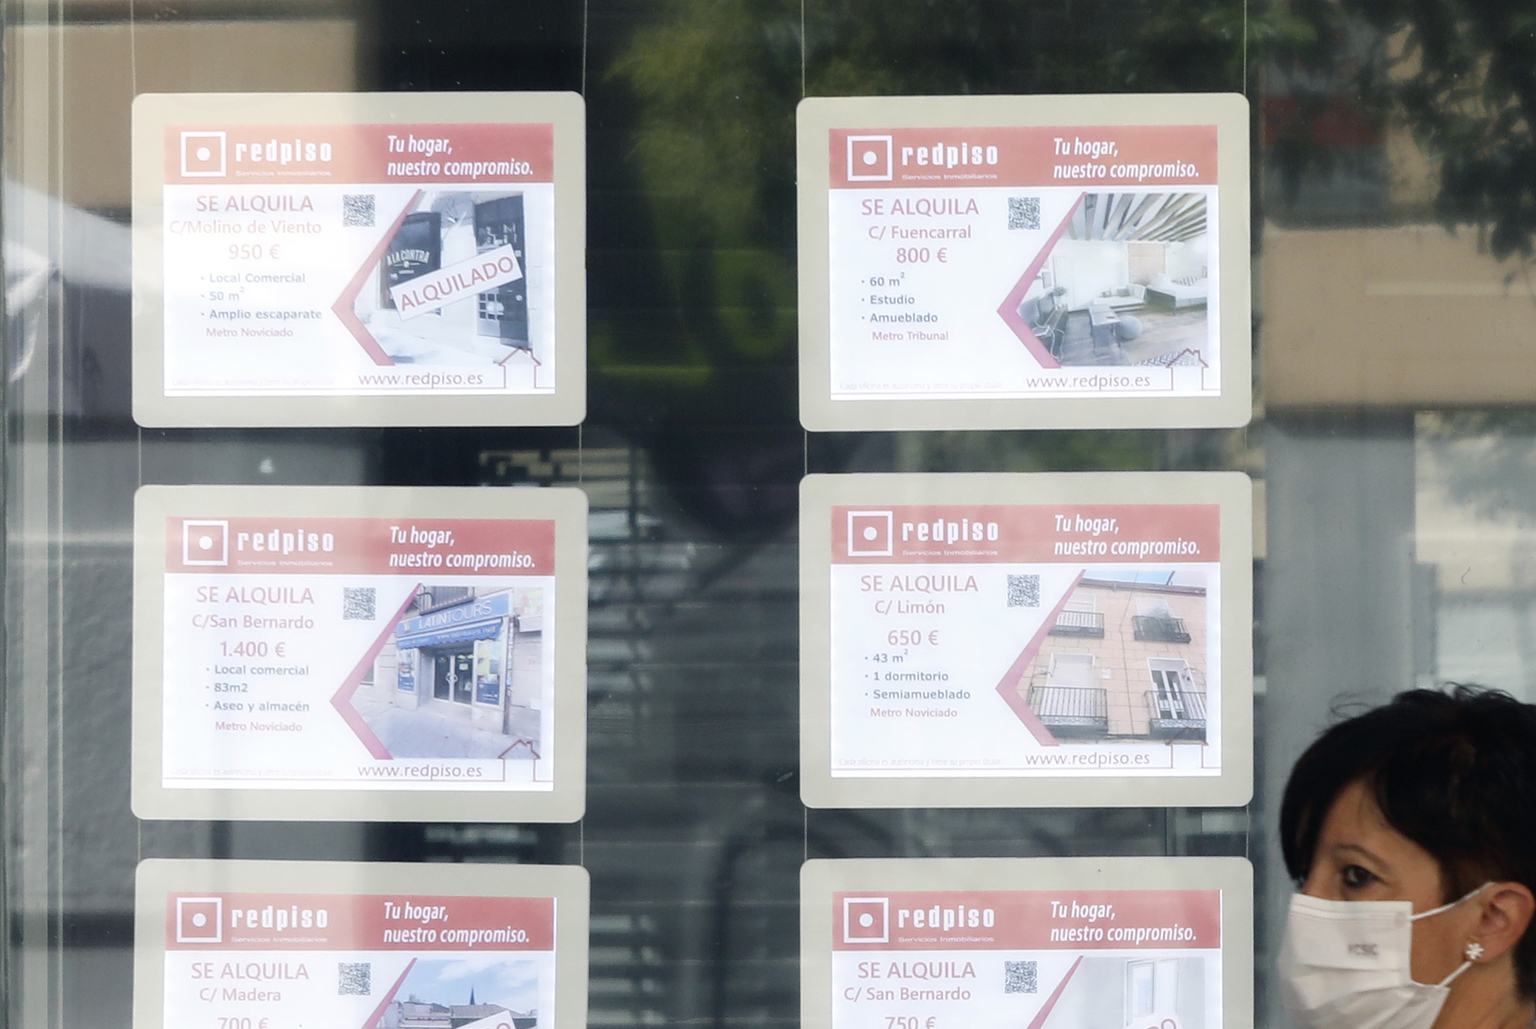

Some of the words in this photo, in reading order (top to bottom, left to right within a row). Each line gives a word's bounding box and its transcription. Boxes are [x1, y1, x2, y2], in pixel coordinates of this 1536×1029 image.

[235, 139, 332, 164] redpiso
[902, 142, 998, 168] redpiso
[196, 195, 220, 211] SE
[225, 195, 313, 213] ALQUILA
[862, 199, 884, 215] SE
[890, 199, 978, 216] ALQUILA
[170, 220, 244, 235] C/Molino
[249, 220, 266, 234] de
[271, 220, 321, 234] Viento
[869, 226, 885, 240] C/
[891, 225, 971, 239] Fuencarral
[896, 248, 930, 263] 800
[936, 248, 947, 263] €
[401, 256, 514, 311] ALQUILADO
[359, 372, 483, 387] www.redpiso.es
[1027, 374, 1150, 390] www.redpiso.es
[902, 519, 998, 544] redpiso
[238, 529, 334, 554] redpiso
[861, 575, 883, 591] SE
[890, 575, 978, 593] ALQUILA
[197, 587, 220, 602] SE
[226, 587, 313, 604] ALQUILA
[875, 600, 892, 615] C/
[898, 600, 945, 613] Limón
[193, 615, 239, 630] C/San
[244, 615, 313, 629] Bernardo
[231, 906, 327, 931] redpiso
[898, 906, 994, 930] redpiso
[191, 963, 214, 978] SE
[220, 963, 309, 980] ALQUILA
[858, 962, 881, 978] SE
[888, 962, 975, 980] ALQUILA
[200, 988, 217, 1002] C/
[222, 988, 281, 1002] Madera
[844, 988, 860, 1002] C/
[867, 987, 895, 1000] San
[900, 987, 971, 1000] Bernardo
